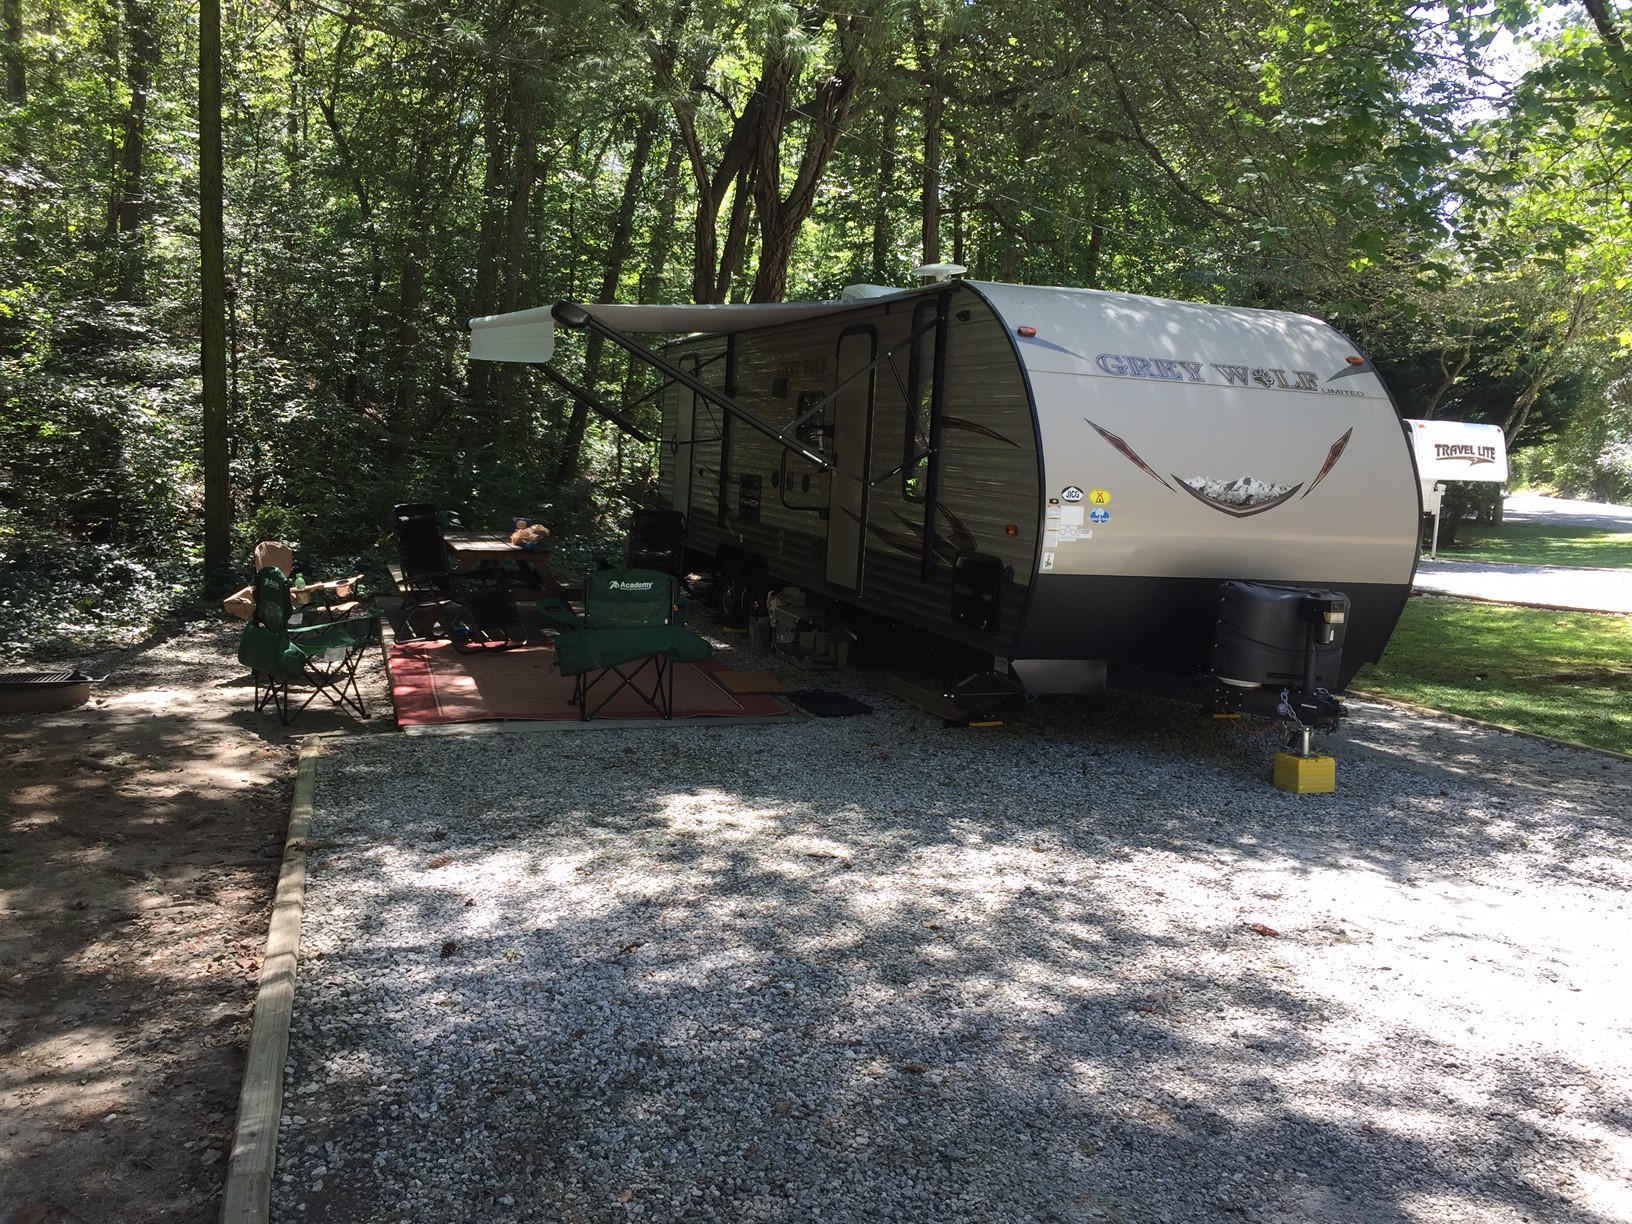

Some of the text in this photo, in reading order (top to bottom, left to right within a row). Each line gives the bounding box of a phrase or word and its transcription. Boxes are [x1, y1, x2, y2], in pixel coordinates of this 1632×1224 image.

[1094, 353, 1205, 383] GREY
[1321, 388, 1365, 397] LIMITED
[1434, 443, 1496, 460] TRAVEL LITE
[620, 581, 654, 590] Academy
